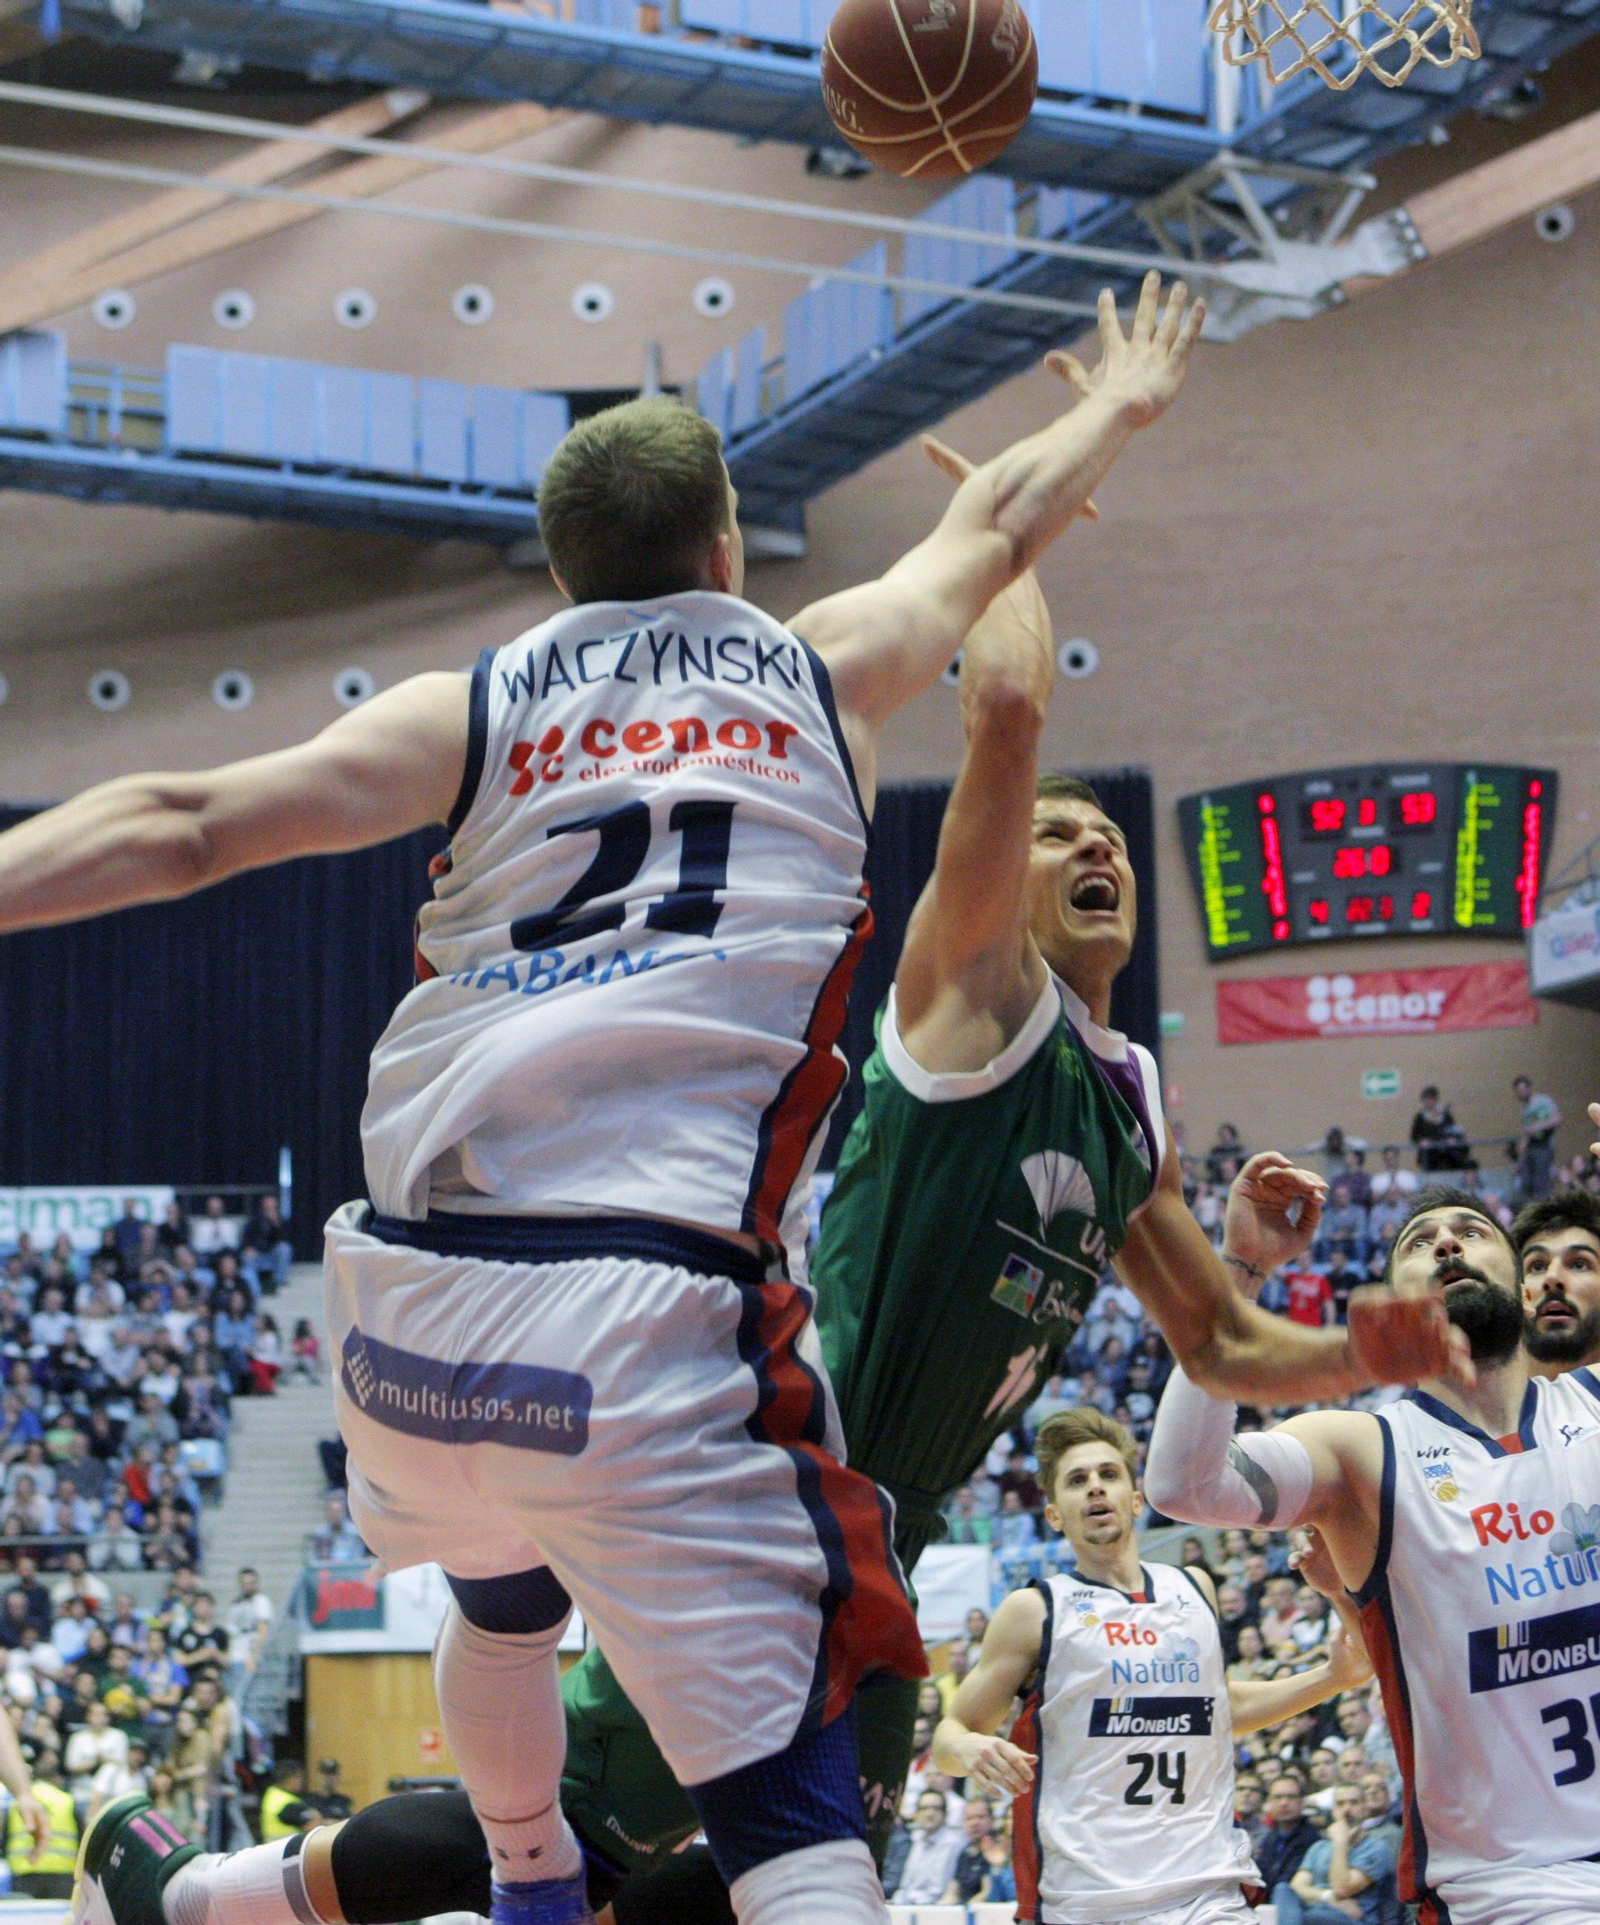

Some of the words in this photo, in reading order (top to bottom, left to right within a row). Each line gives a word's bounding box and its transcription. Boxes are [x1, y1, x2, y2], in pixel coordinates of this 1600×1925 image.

[501, 630, 802, 703] WACZYNSKI
[580, 716, 800, 759] cenor
[510, 798, 738, 952] 21
[380, 1379, 575, 1432] multiusos.net
[1470, 1502, 1555, 1547] Rio
[1485, 1546, 1600, 1606] Natur
[1104, 1622, 1157, 1646] Rio
[1498, 1635, 1600, 1683] MONBU
[1111, 1658, 1200, 1685] Natura
[1124, 1751, 1186, 1806] 24
